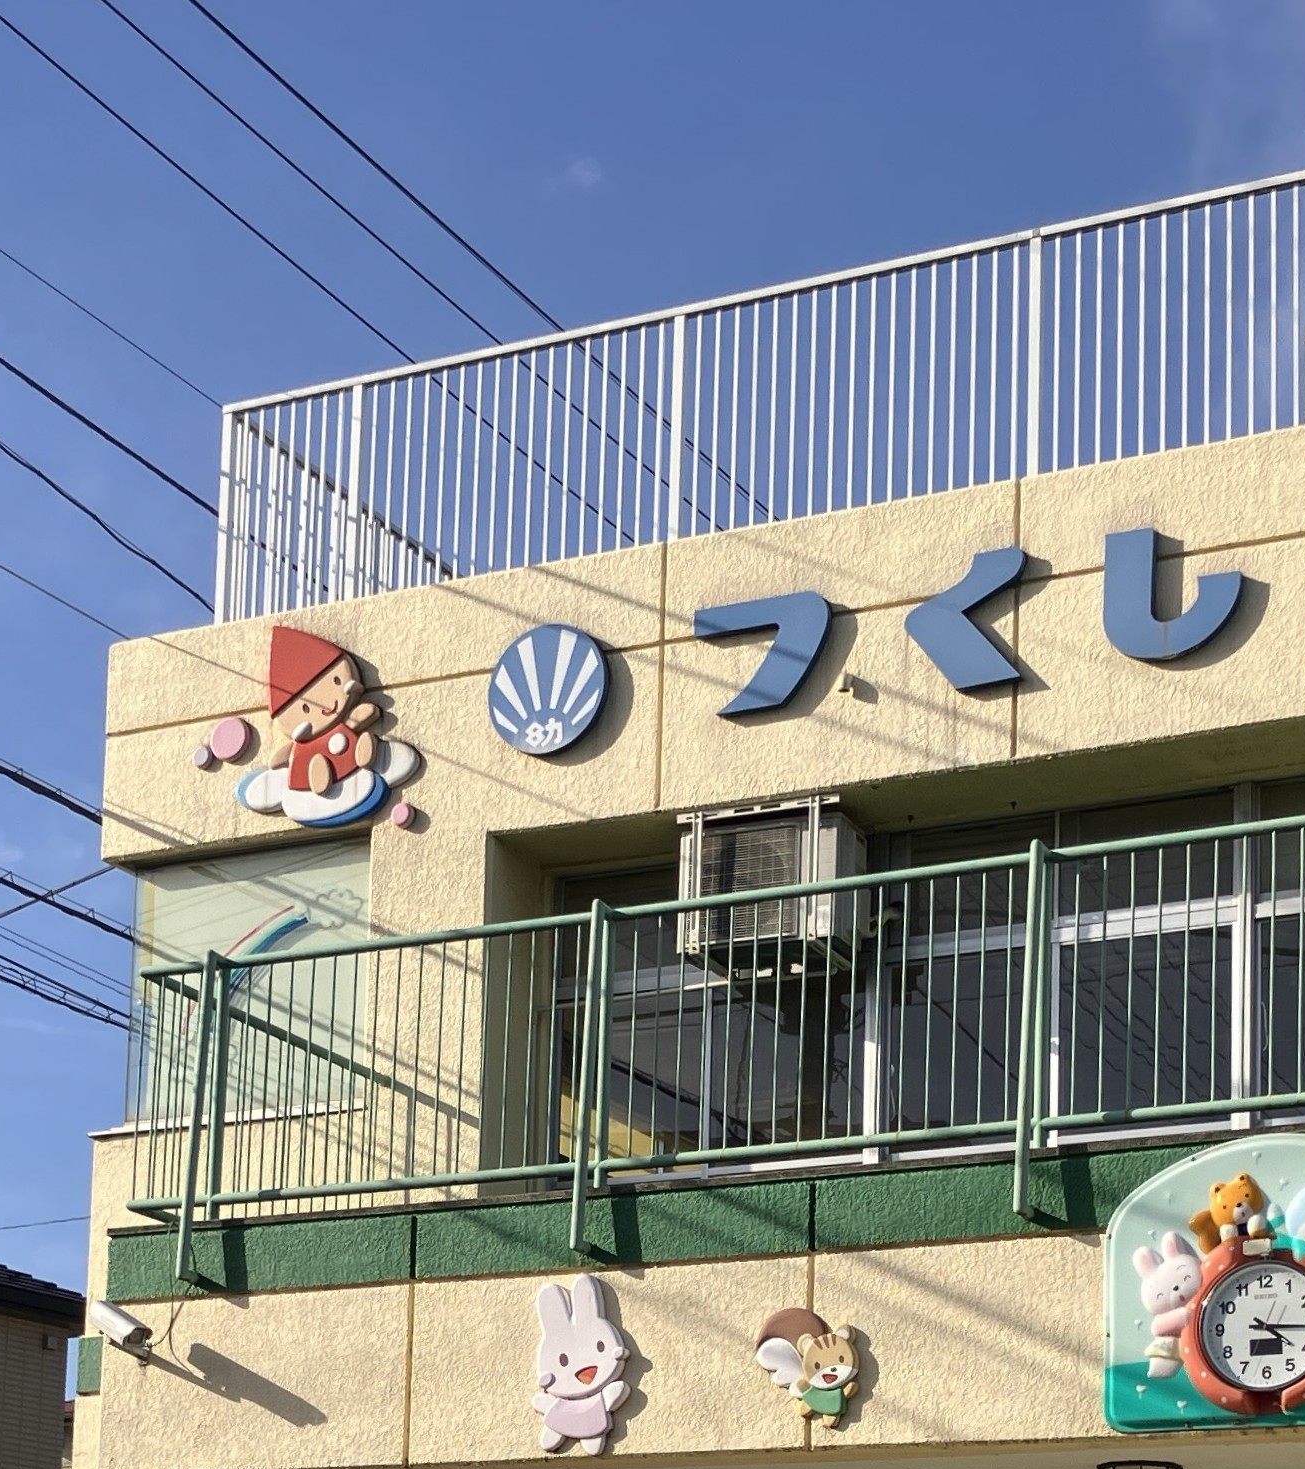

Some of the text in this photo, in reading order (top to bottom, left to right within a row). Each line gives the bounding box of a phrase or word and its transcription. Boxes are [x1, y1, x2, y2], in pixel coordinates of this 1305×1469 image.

[1257, 1274, 1274, 1289] 12
[1285, 1279, 1293, 1294] 1
[1236, 1283, 1249, 1297] 11
[1219, 1300, 1237, 1315] 10
[1215, 1323, 1225, 1337] 9
[1223, 1345, 1233, 1359] 8
[1239, 1361, 1250, 1375] 7
[1285, 1358, 1296, 1372] 5
[1261, 1365, 1272, 1380] 6
